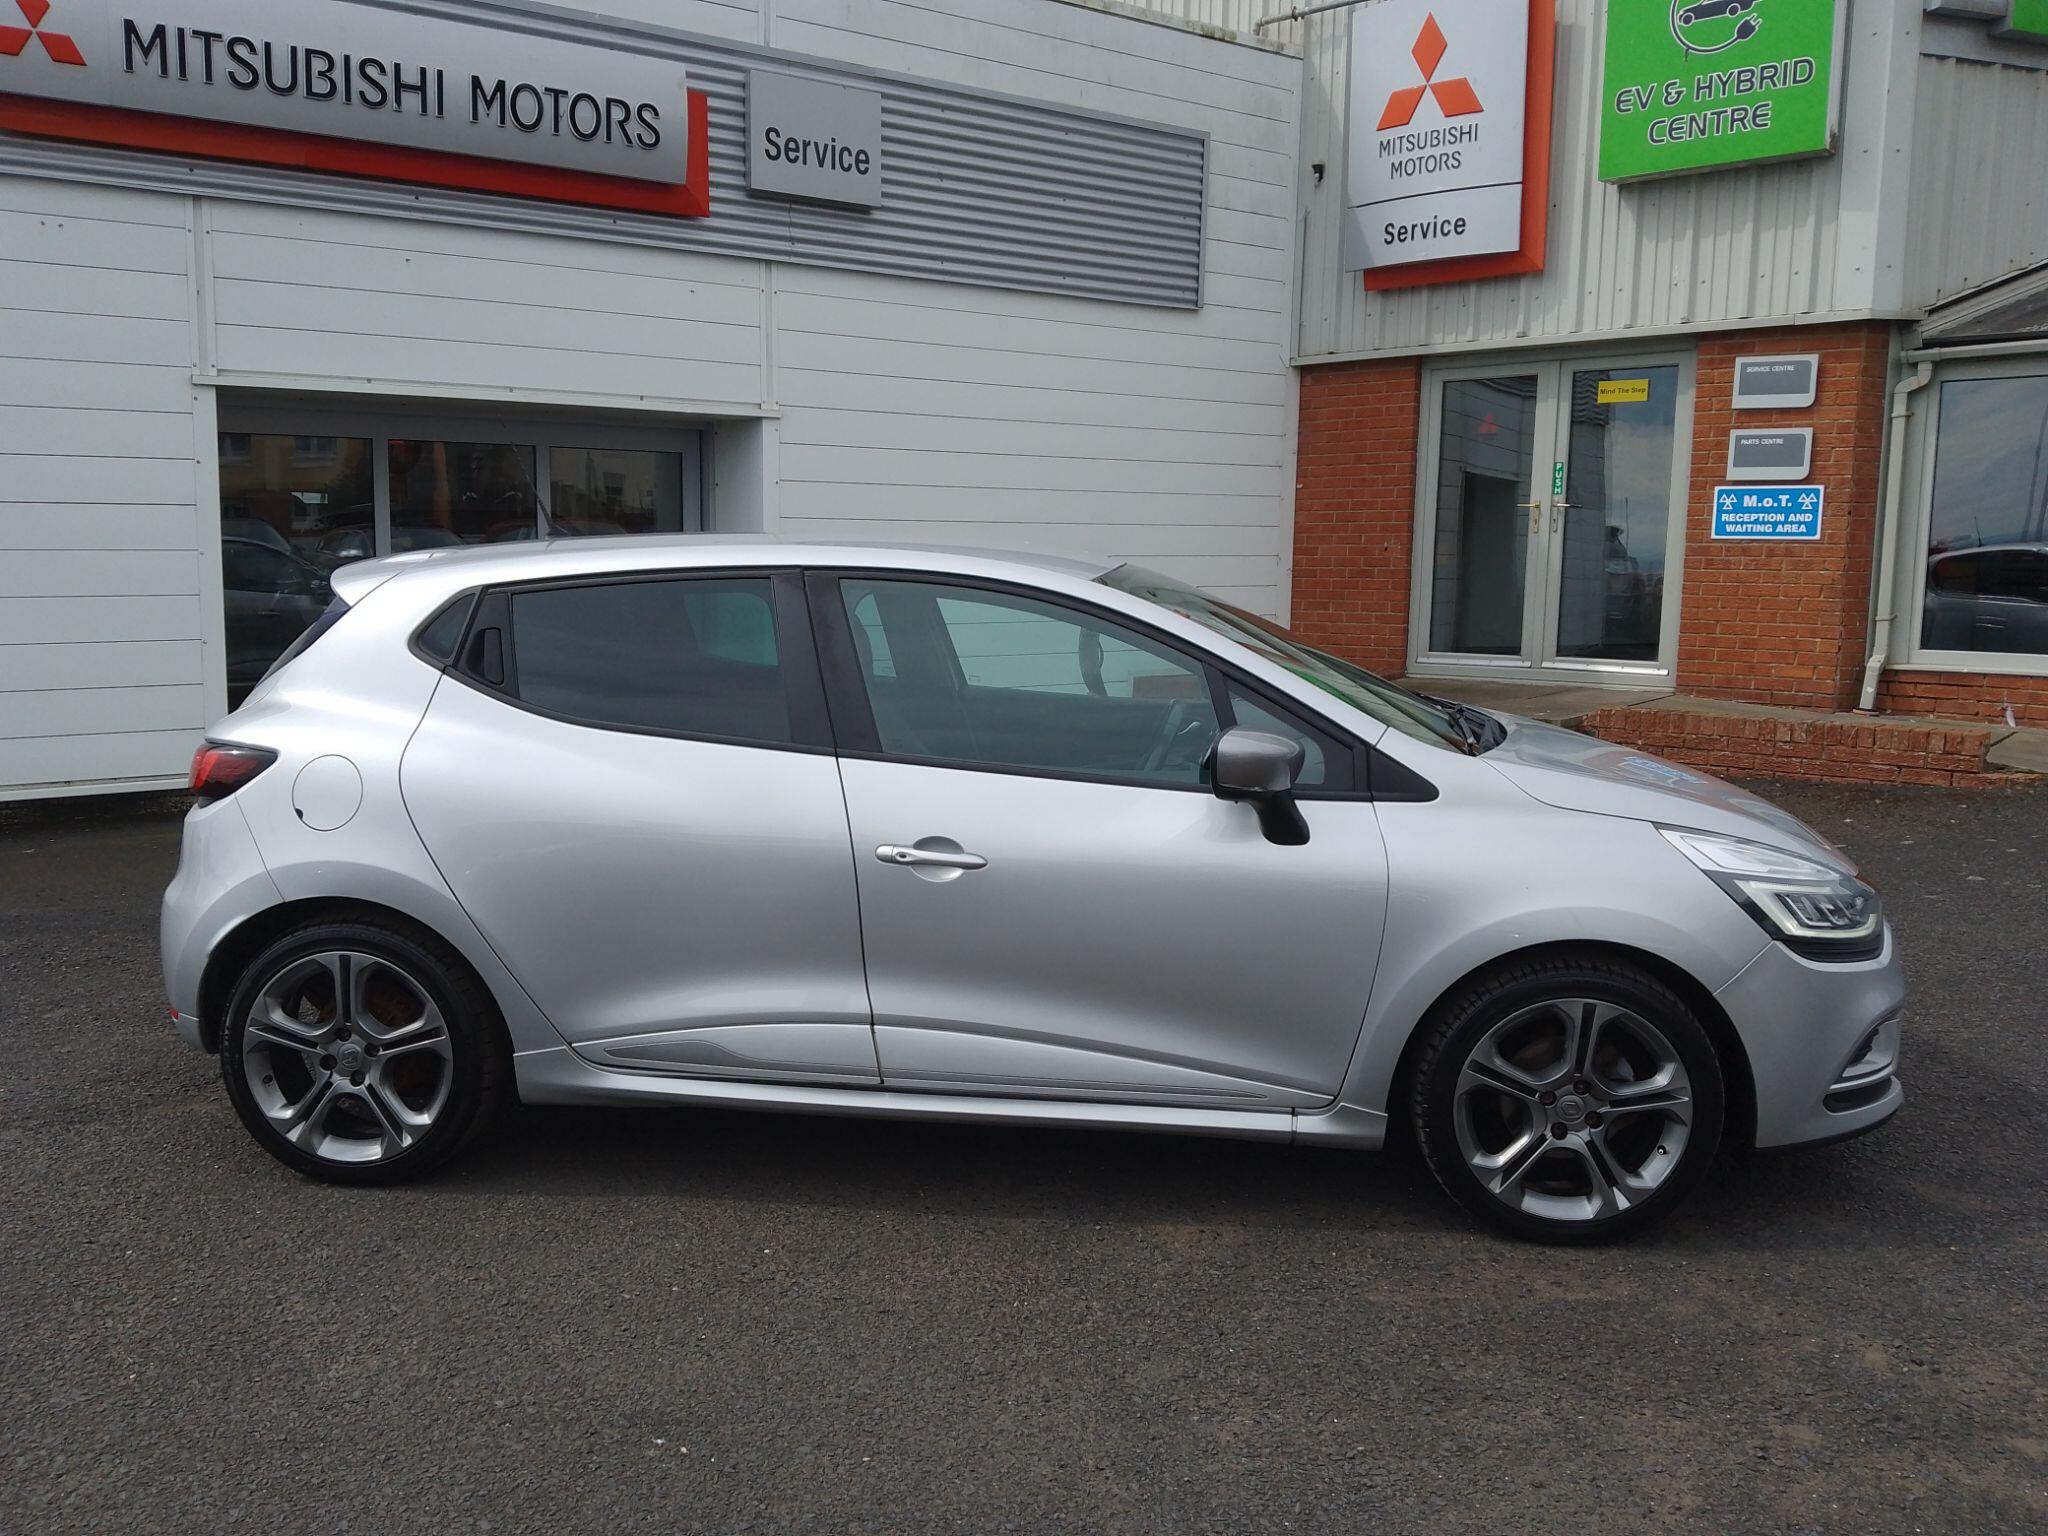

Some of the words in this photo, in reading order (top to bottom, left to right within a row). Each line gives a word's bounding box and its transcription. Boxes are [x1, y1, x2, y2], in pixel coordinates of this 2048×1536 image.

[121, 17, 446, 119] MITSUBISHI
[469, 73, 662, 151] MOTORS
[1615, 83, 1656, 113] EV
[1663, 80, 1686, 106] &
[1694, 57, 1815, 102] HYBRID
[1648, 101, 1772, 145] CENTRE
[764, 126, 870, 175] Service
[1378, 122, 1479, 158] MITSUBISHI
[1390, 150, 1462, 180] MOTORS
[1383, 215, 1467, 245] Service
[1554, 463, 1562, 493] PUSH
[1743, 495, 1792, 507] M.o.T.
[1722, 513, 1785, 522] RECEPTION
[1788, 513, 1813, 522] AND
[1726, 524, 1773, 533] WAITING
[1775, 523, 1807, 533] AREA
